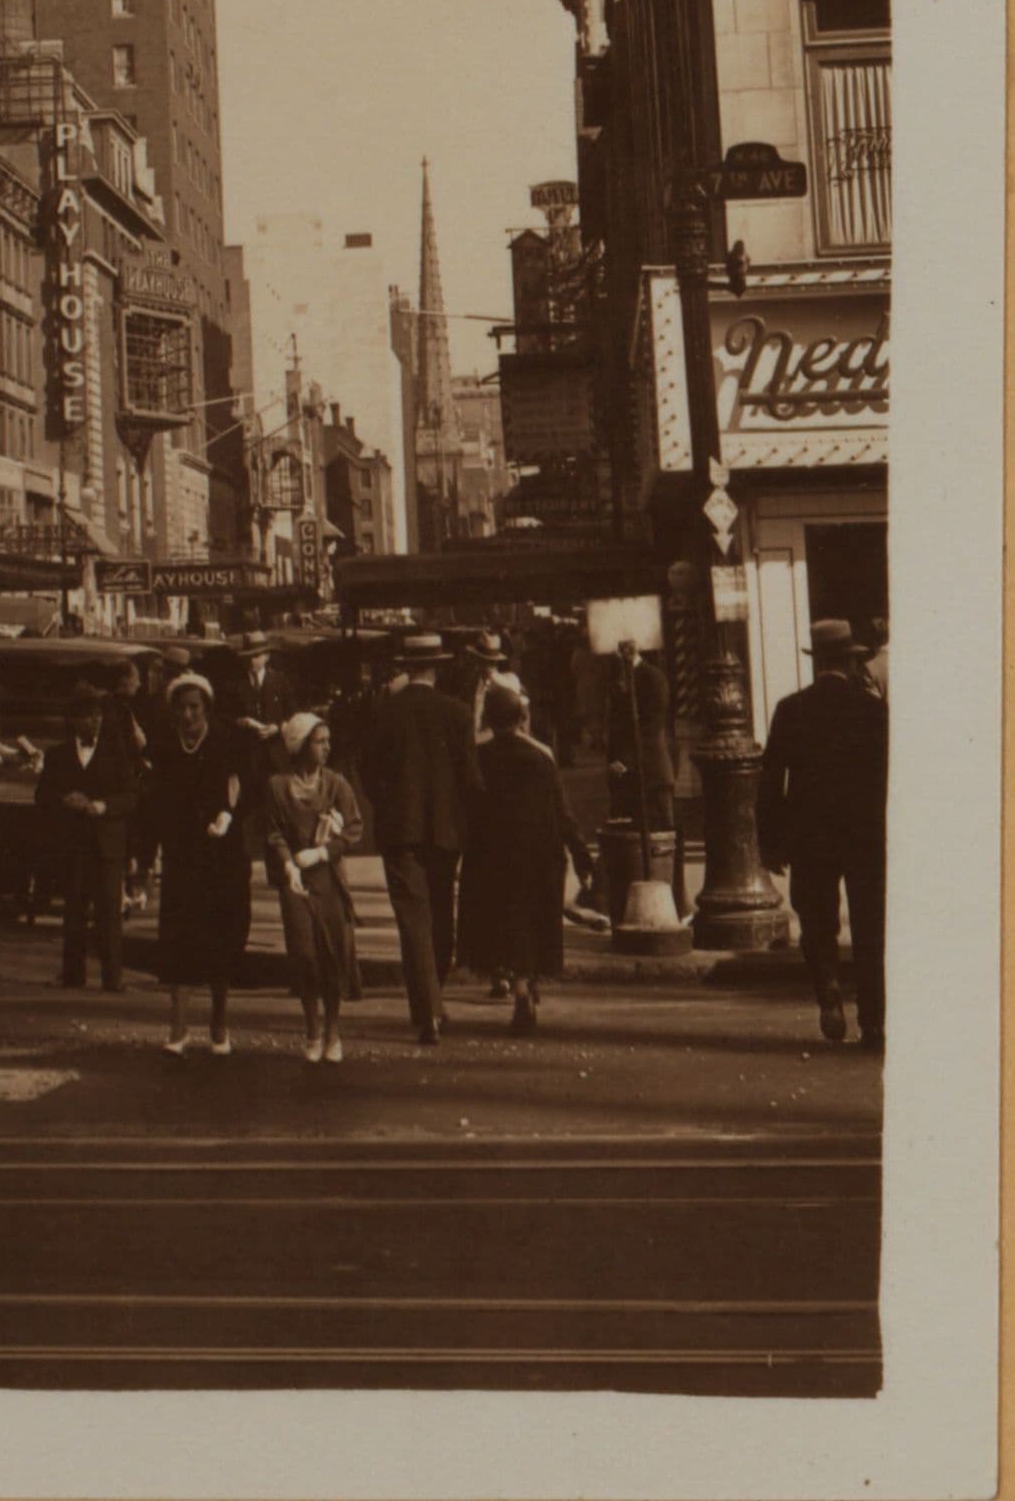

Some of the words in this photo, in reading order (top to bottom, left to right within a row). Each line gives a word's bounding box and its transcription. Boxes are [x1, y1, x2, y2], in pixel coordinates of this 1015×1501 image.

[758, 169, 797, 191] AVE
[56, 123, 85, 422] PLAYHOUSE
[153, 569, 235, 588] AYHOUS
